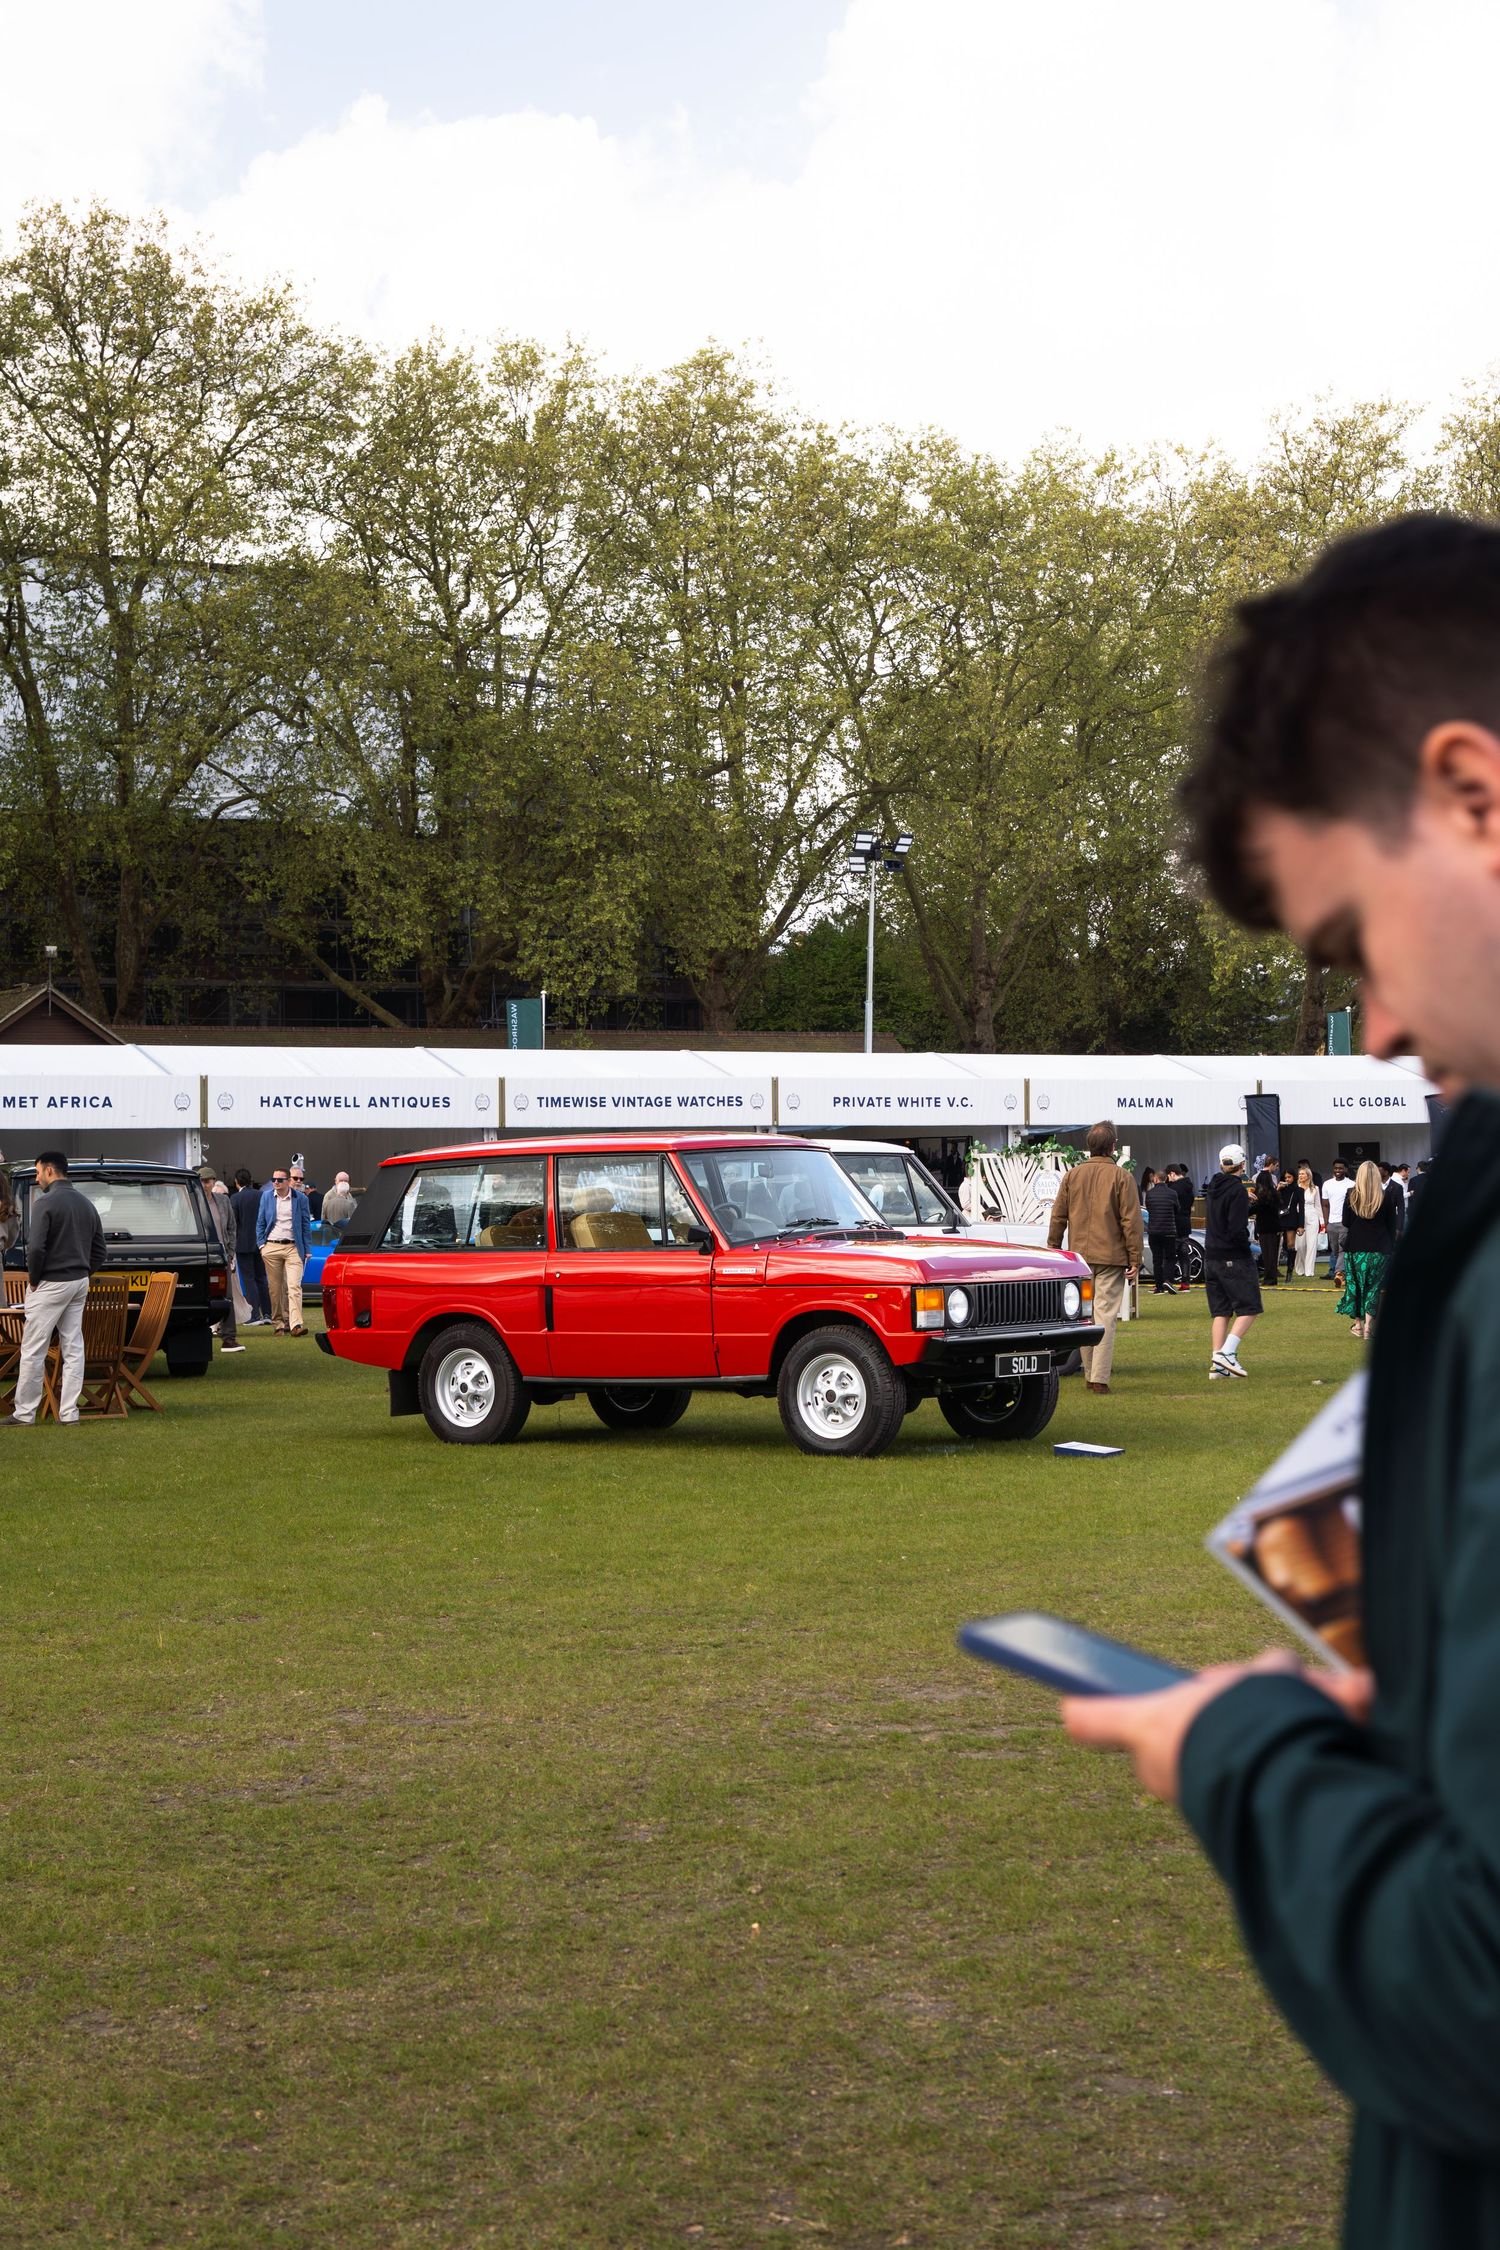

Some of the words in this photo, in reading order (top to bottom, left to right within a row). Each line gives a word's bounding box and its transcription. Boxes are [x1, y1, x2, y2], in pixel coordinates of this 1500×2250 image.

[2, 1096, 39, 1108] MET
[46, 1096, 113, 1108] AFRICA
[260, 1096, 361, 1108] HATCHWELL
[367, 1096, 451, 1109] ANTIQUES
[536, 1096, 607, 1108] TIMEWISE
[611, 1096, 672, 1108] VINTAGE
[676, 1096, 743, 1108] WATCHES
[833, 1096, 891, 1108] PRIVATE
[897, 1096, 941, 1108] WHITE
[946, 1096, 974, 1108] V.C.
[1117, 1097, 1174, 1108] MALMAN
[1333, 1096, 1354, 1108] LLC
[1359, 1096, 1407, 1108] GLOBAL
[130, 1275, 148, 1287] KU
[1012, 1356, 1038, 1373] SOLD
